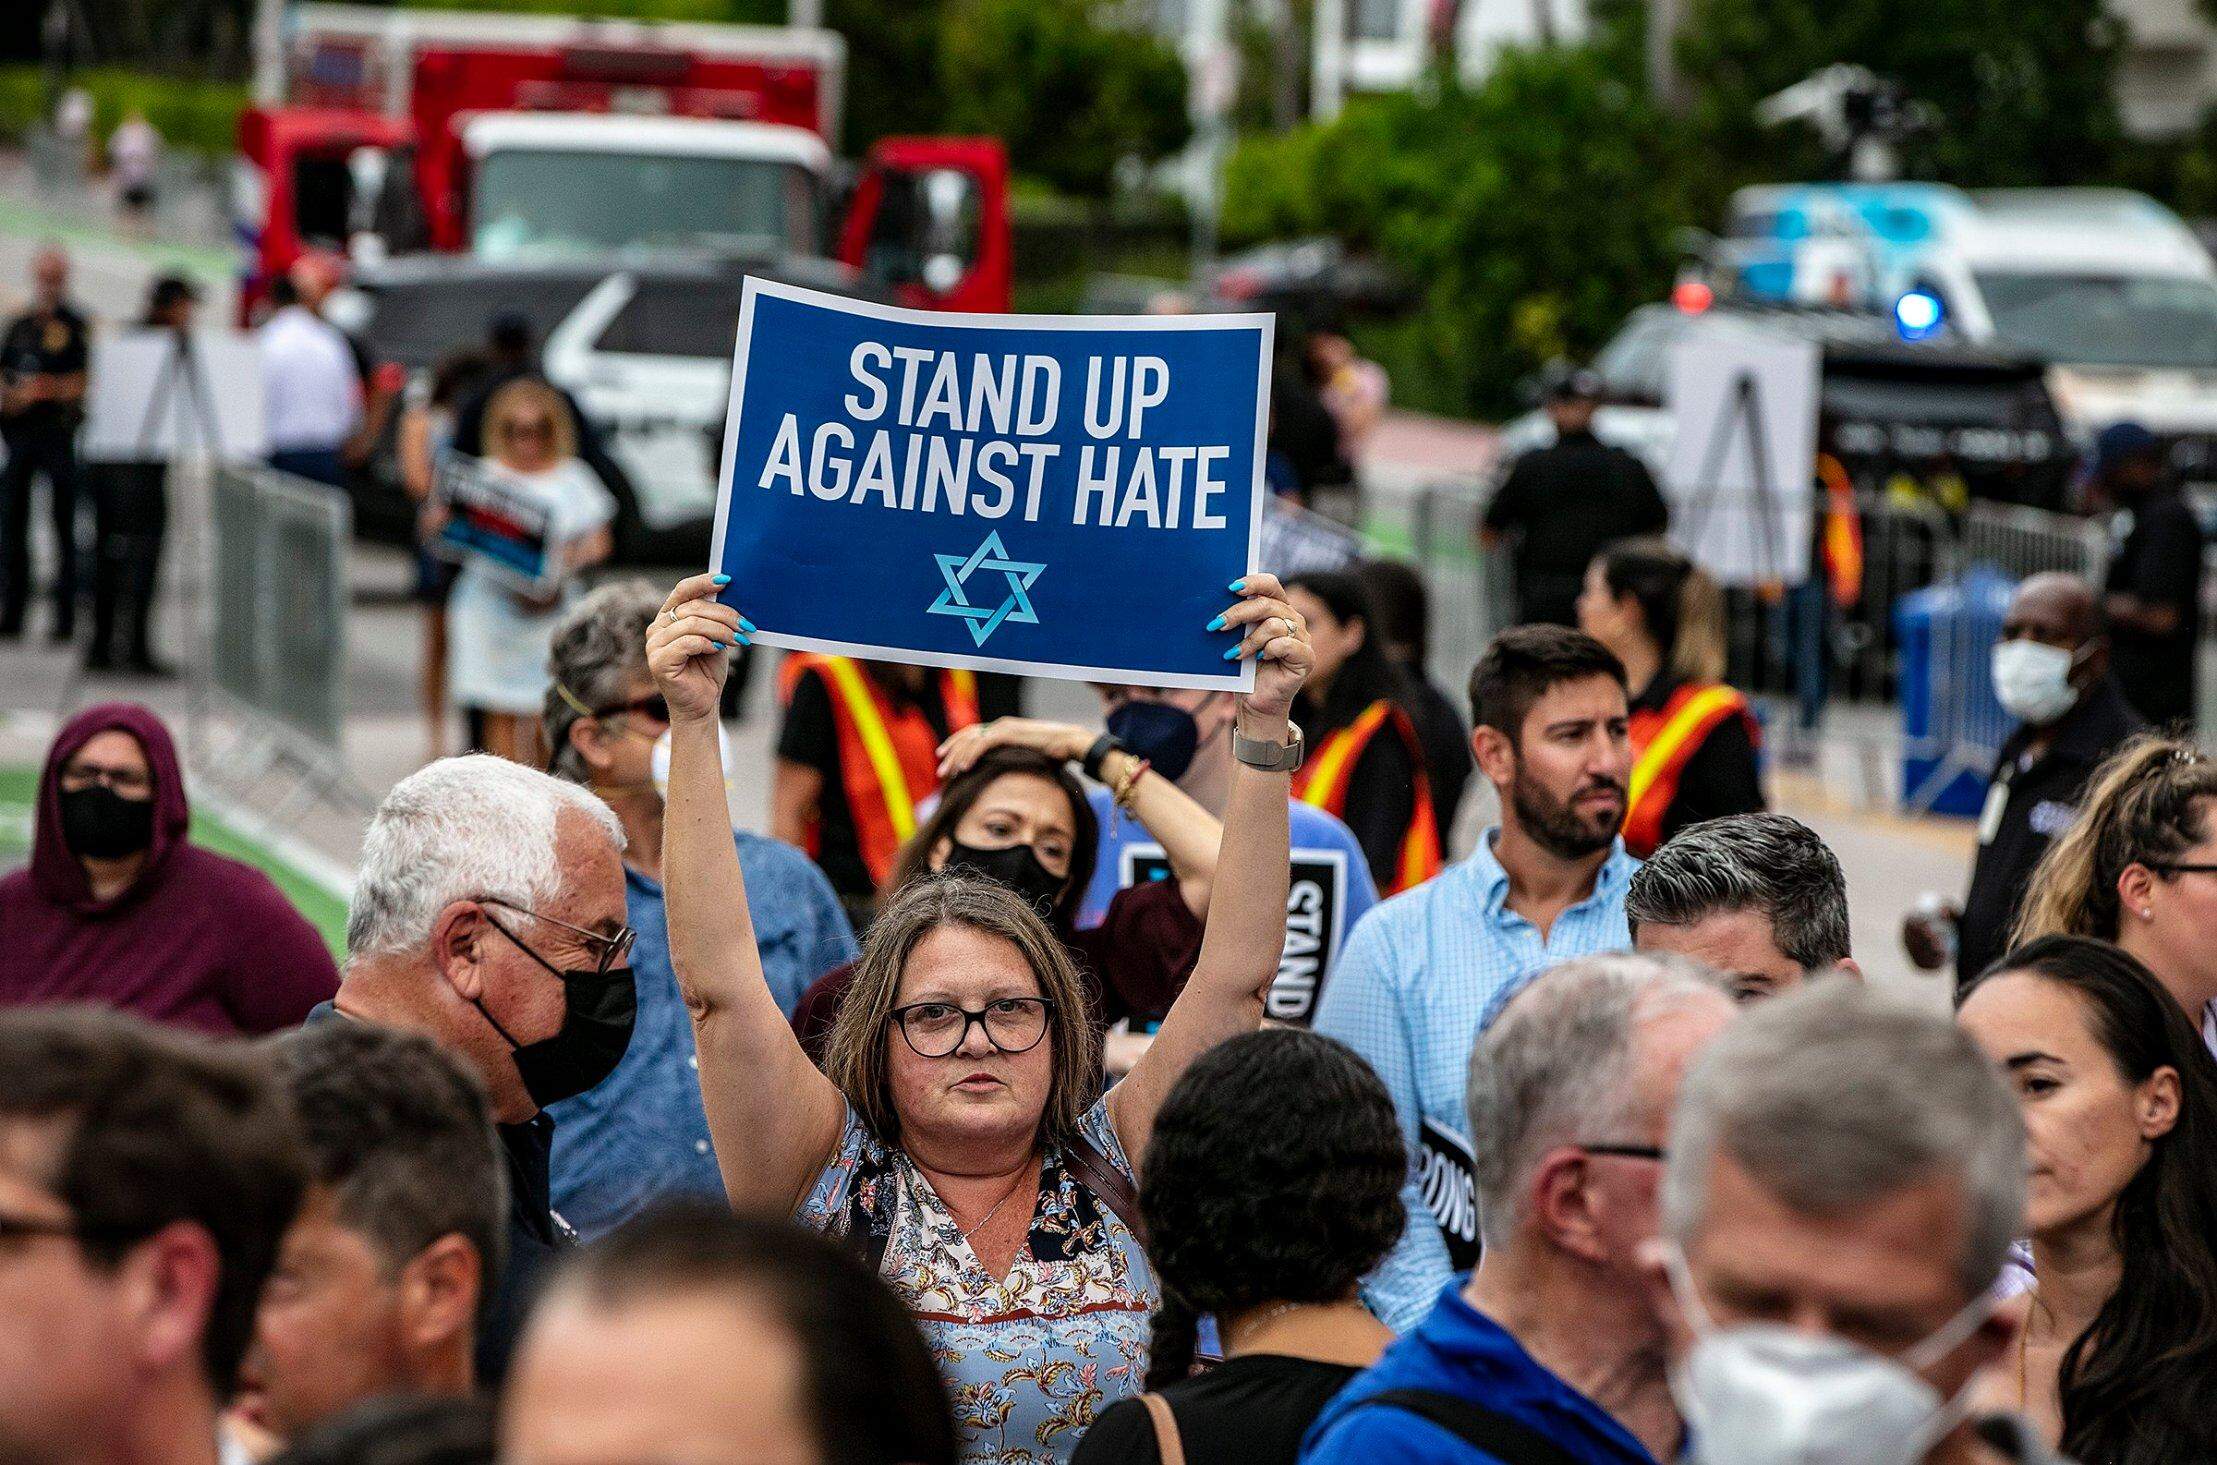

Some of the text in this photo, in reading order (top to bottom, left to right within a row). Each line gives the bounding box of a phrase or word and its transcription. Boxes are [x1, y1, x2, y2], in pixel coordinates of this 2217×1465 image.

[844, 341, 1170, 440] STAND UP
[757, 412, 1230, 529] AGAINST HATE
[1266, 879, 1324, 1018] STAND
